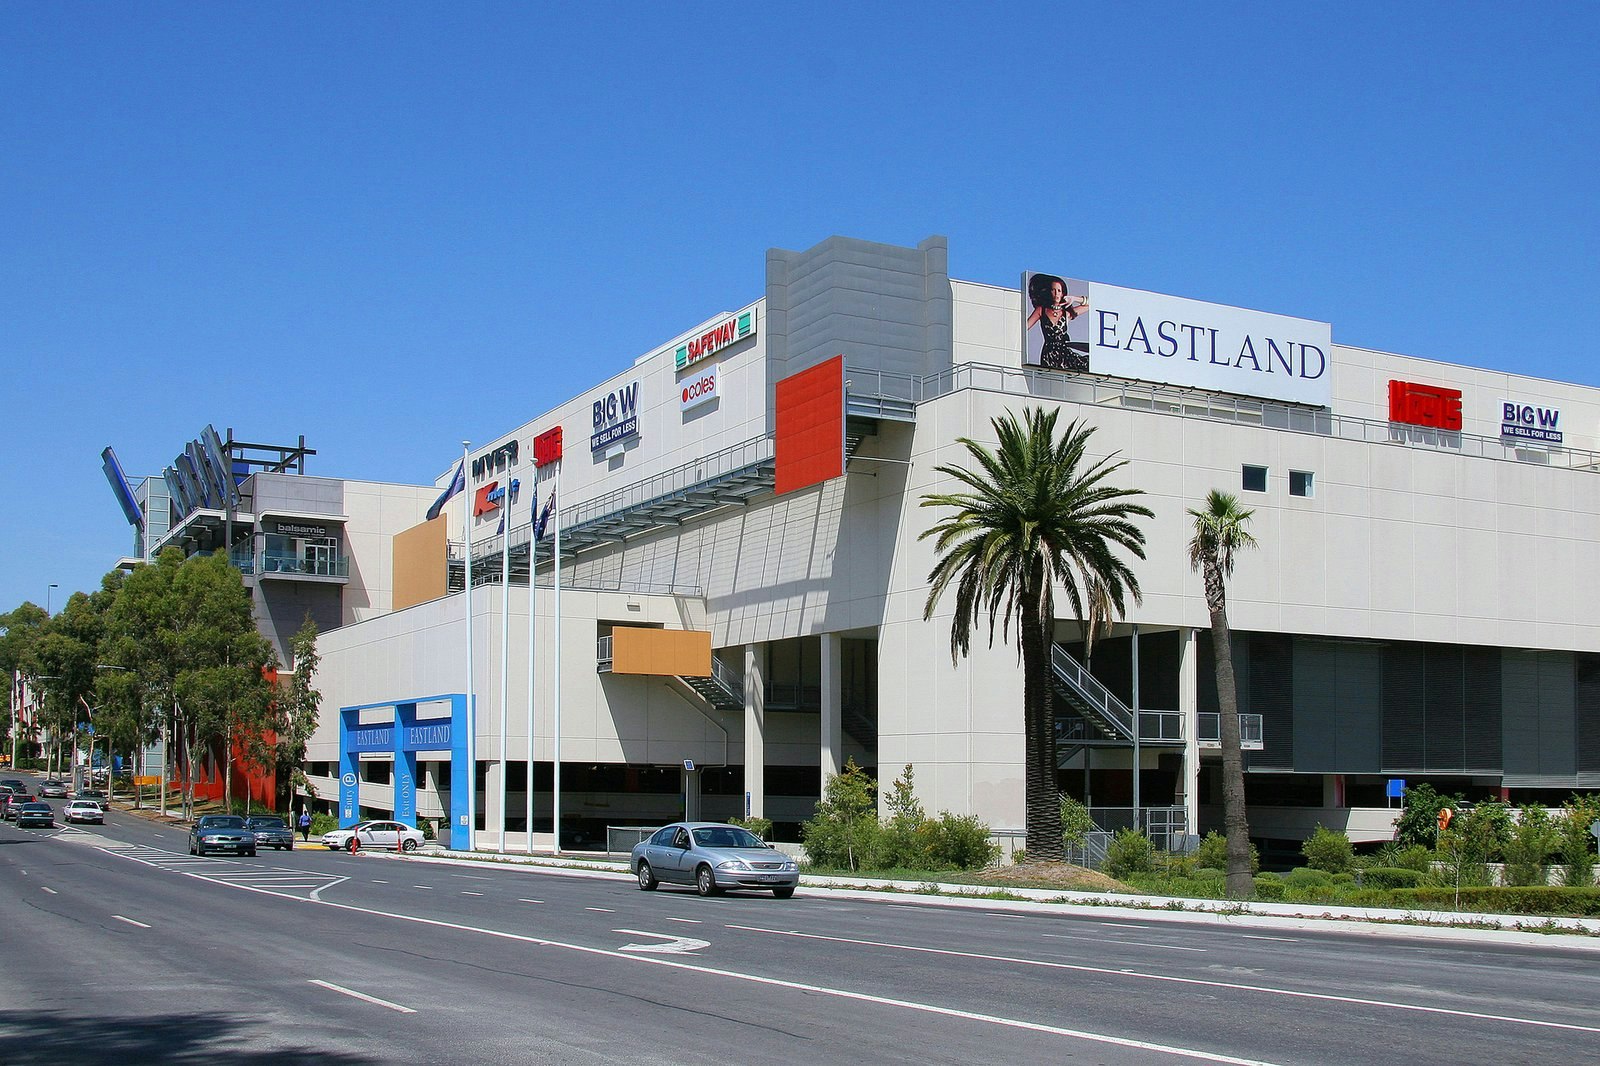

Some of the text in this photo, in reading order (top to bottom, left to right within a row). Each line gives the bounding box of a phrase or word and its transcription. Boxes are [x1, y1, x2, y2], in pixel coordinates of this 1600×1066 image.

[687, 319, 737, 361] SAFEWAY
[1095, 309, 1326, 380] EASTLAND
[688, 375, 715, 400] coles
[593, 381, 638, 428] BIG W
[1503, 402, 1559, 427] BIG W
[600, 431, 612, 443] SELL
[612, 426, 622, 439] FOR
[623, 420, 636, 434] LESS
[1503, 426, 1561, 440] WE SELL FOR LESS
[277, 523, 326, 534] balsamic
[357, 728, 389, 745] EASTLAND
[410, 725, 450, 745] EASTLAND
[402, 773, 410, 798] ONLY
[344, 789, 355, 810] Entry
